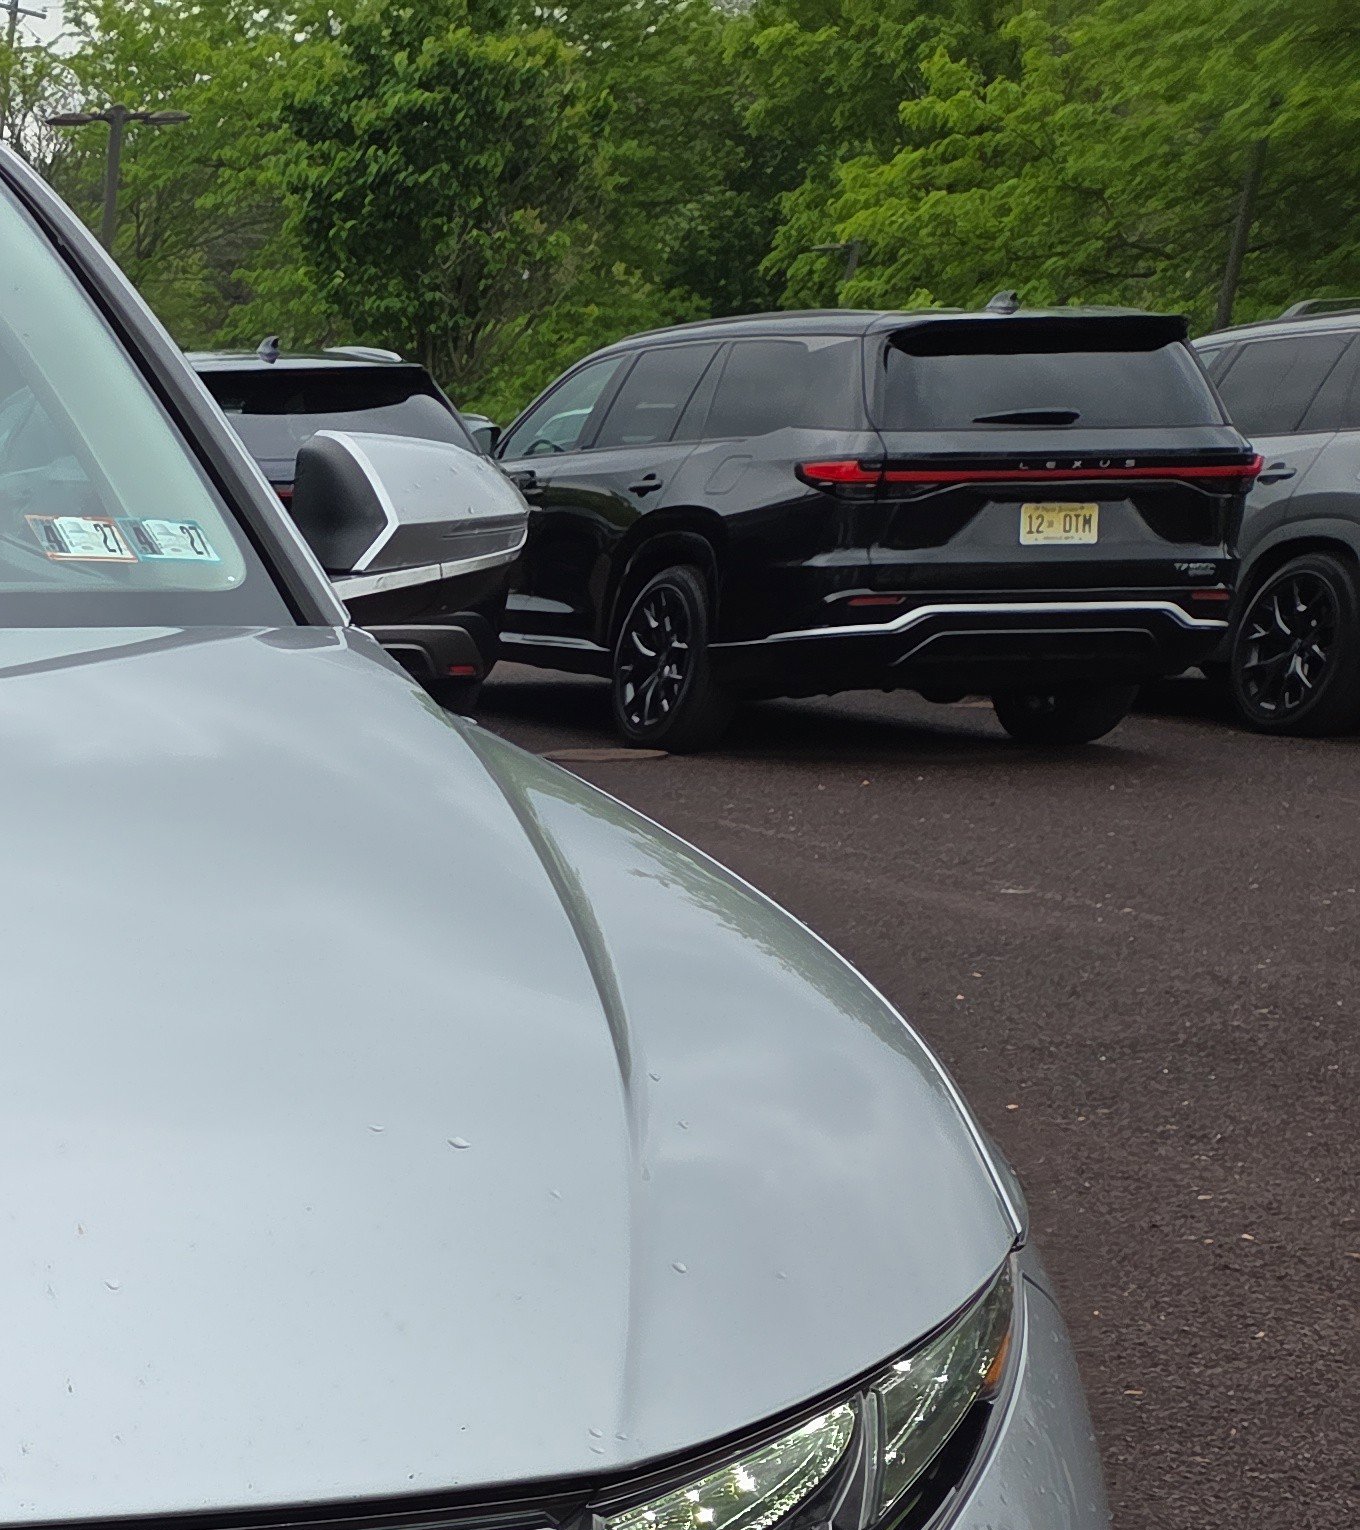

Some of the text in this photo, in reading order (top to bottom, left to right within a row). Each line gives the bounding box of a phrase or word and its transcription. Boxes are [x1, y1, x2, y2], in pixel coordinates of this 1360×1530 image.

[1018, 459, 1136, 470] LEXUS
[1026, 513, 1045, 535] 12
[93, 523, 123, 555] 27
[179, 525, 212, 558] 27
